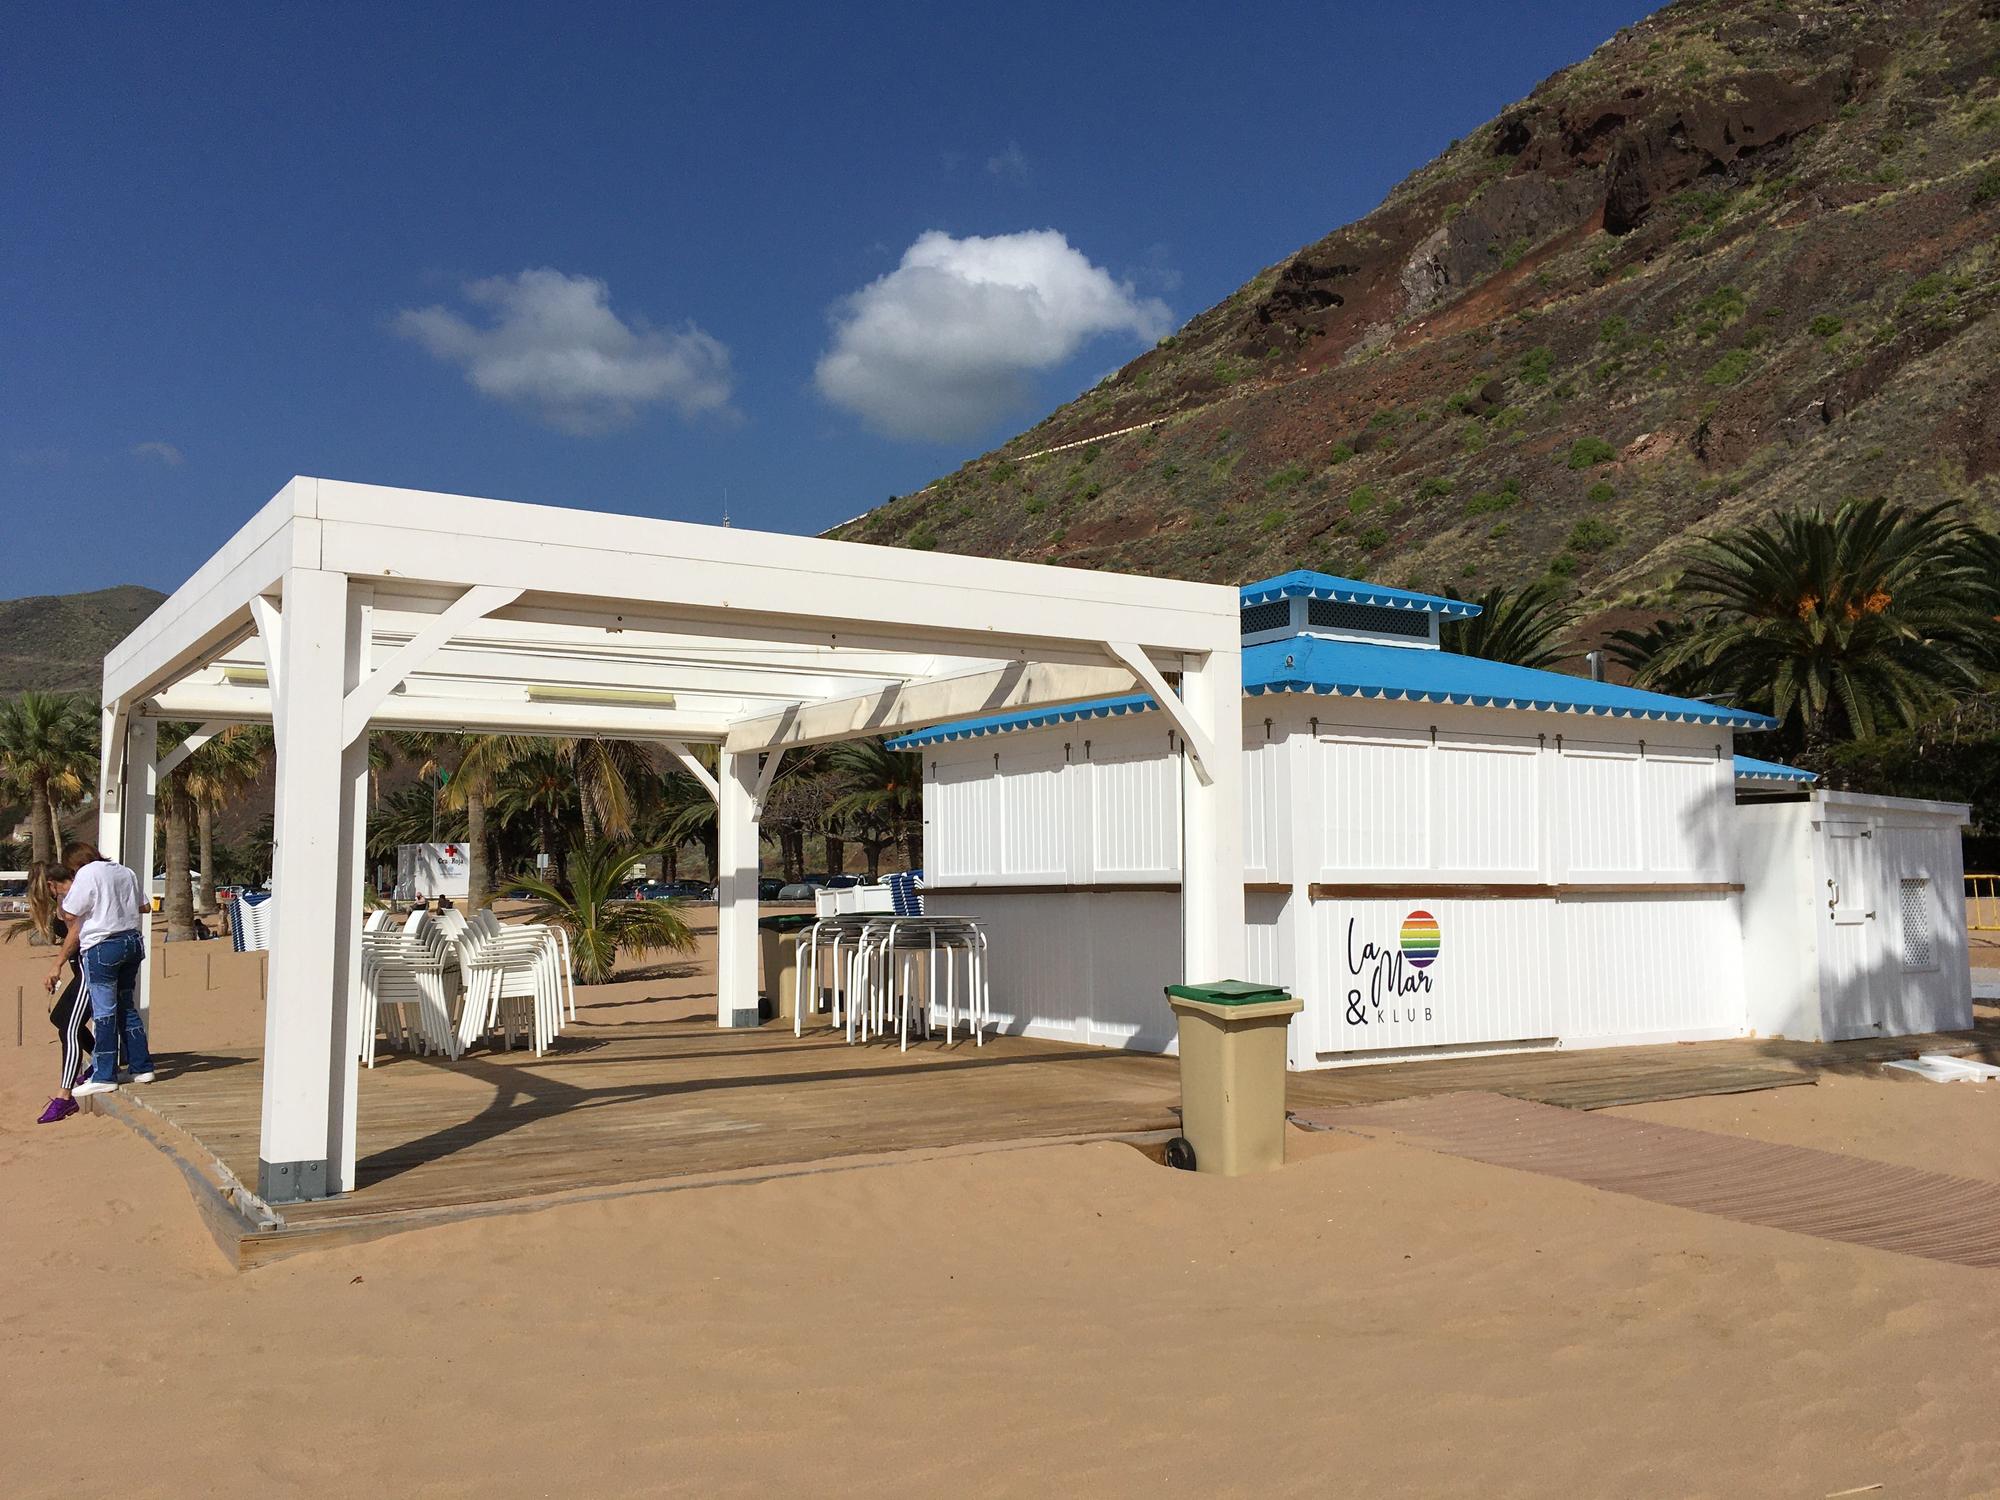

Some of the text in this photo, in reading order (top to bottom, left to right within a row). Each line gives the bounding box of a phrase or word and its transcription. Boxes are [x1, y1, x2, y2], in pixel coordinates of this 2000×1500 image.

[1347, 917, 1381, 975] La
[1345, 989, 1433, 1025] & KLUB
[1371, 949, 1433, 1008] Mar
